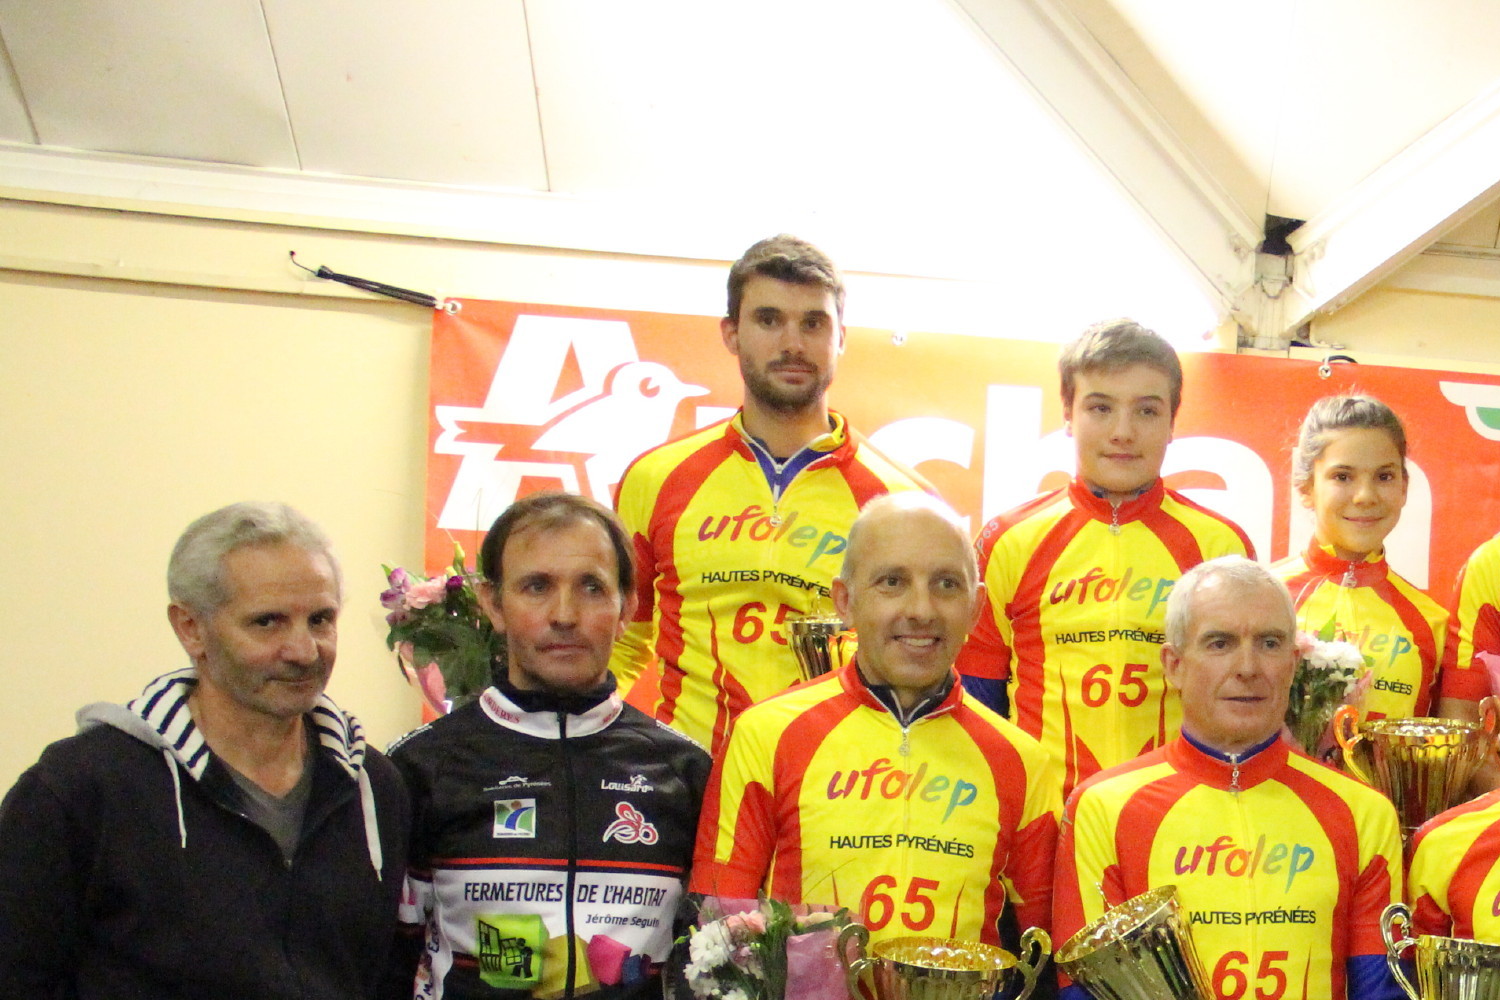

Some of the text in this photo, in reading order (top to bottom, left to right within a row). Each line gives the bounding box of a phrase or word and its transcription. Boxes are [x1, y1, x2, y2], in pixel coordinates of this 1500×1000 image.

[434, 314, 1432, 592] Achan
[697, 504, 848, 568] ufolep
[701, 569, 760, 584] HAUTES
[1050, 567, 1176, 619] ufolep
[732, 602, 804, 646] 65
[1055, 627, 1166, 645] HAUTES PYRÉNÉE
[1081, 663, 1149, 708] 65
[827, 758, 977, 824] ufolep
[829, 833, 975, 858] HAUTES PYRÉNÉES
[1174, 834, 1315, 894] ufolep
[464, 882, 667, 907] FERMETURES DE L'HABITAT
[862, 875, 940, 932] 65
[1245, 905, 1317, 926] PYRÉNÉES
[585, 914, 660, 929] Jérôme Seguin
